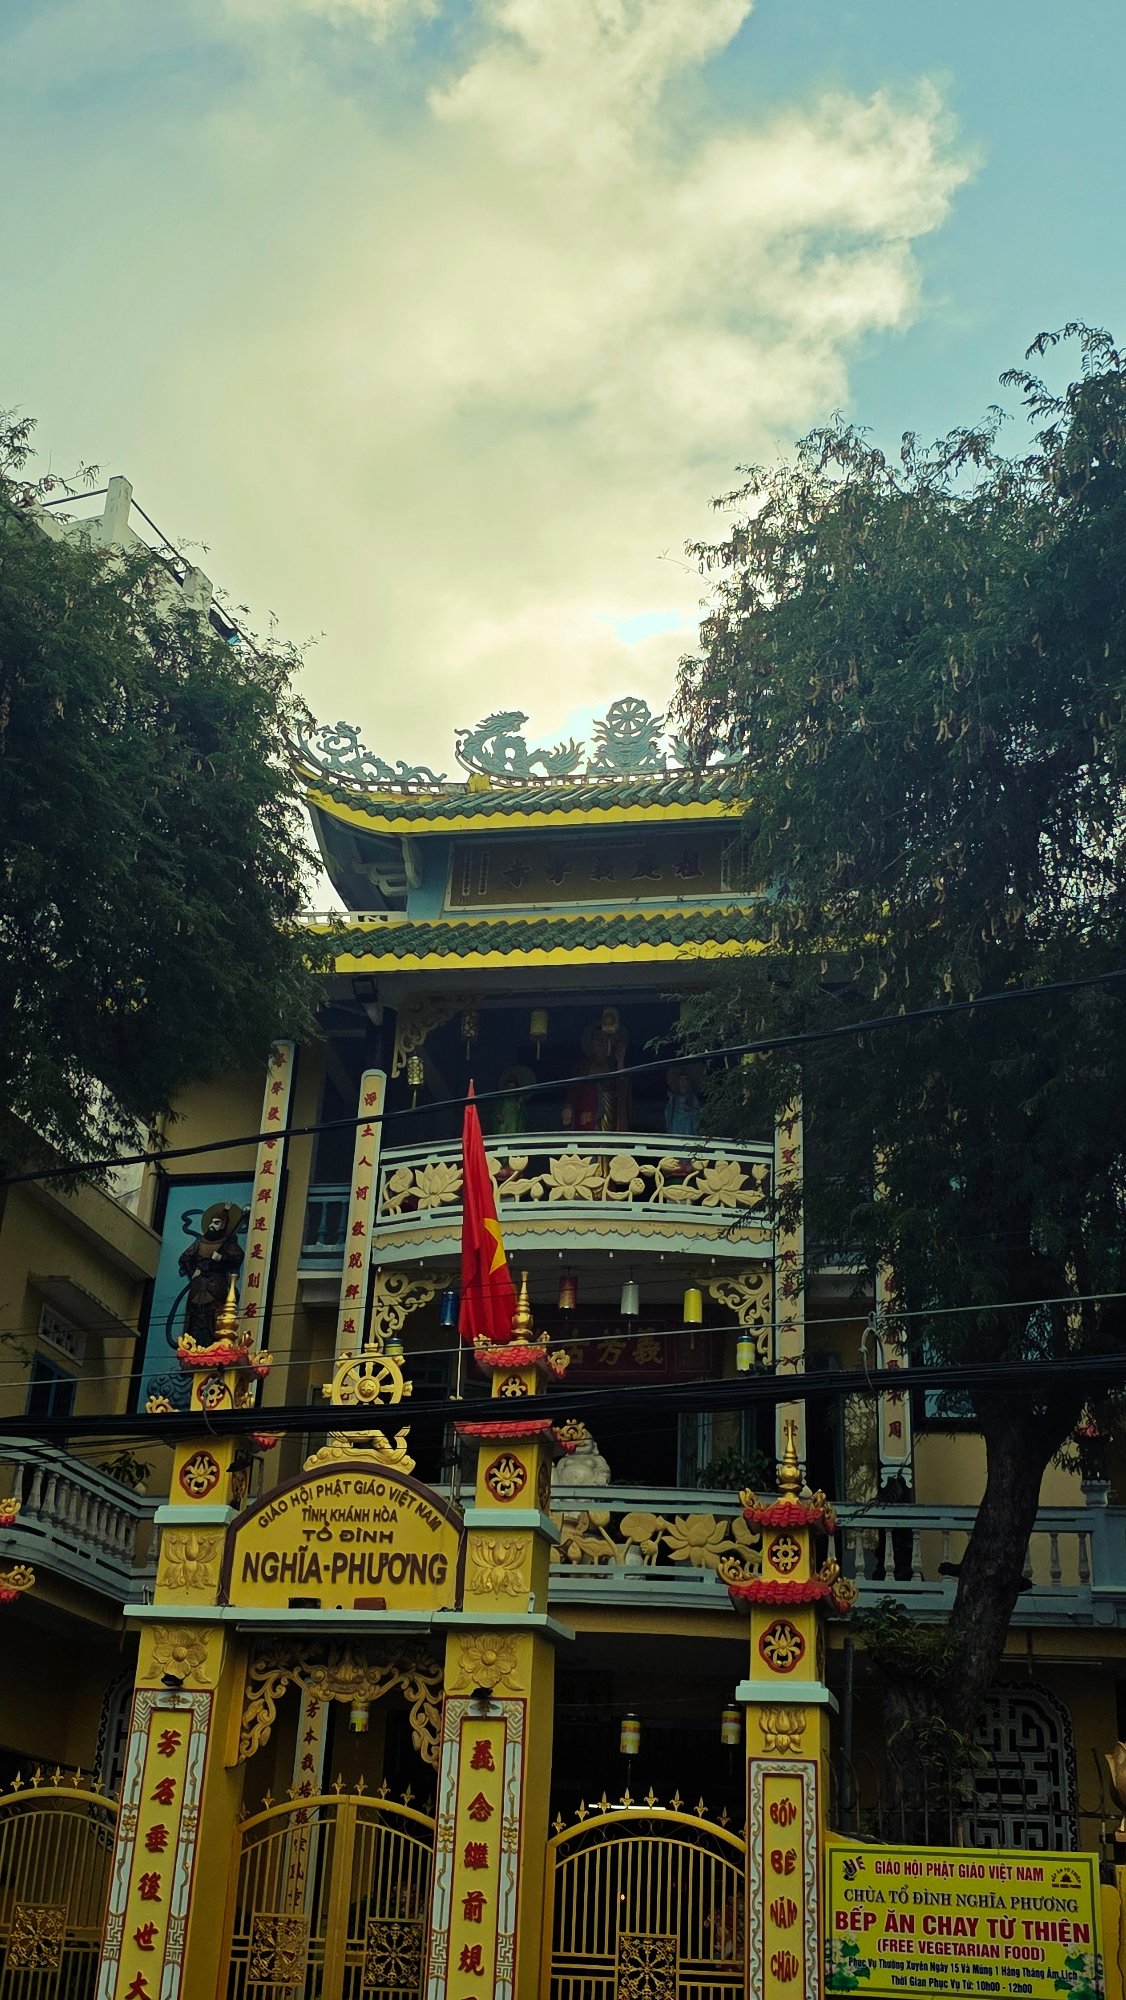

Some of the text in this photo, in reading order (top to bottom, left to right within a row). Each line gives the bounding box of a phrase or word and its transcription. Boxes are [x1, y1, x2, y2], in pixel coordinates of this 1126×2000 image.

[257, 1479, 444, 1532] GIÁO HỘI PHẬT GIÁO VIỆT NAM
[330, 1505, 370, 1522] KHÁNH
[373, 1505, 398, 1523] HÒA
[302, 1521, 394, 1544] TỔ ĐÌNH
[241, 1545, 448, 1585] NGHĨA-PHƯƠNG
[769, 1797, 797, 1827] BỐN
[457, 1739, 496, 2000] 義念繼前規
[874, 1860, 901, 1875] GIÁO
[904, 1861, 923, 1878] HỘI
[926, 1861, 955, 1881] PHẬT
[958, 1862, 986, 1879] GIÁO
[988, 1864, 1013, 1883] VIỆT
[1016, 1867, 1044, 1883] NAM
[769, 1896, 798, 1929] NĂM
[843, 1884, 1079, 1913] CHÙA TỔ ĐÌNH NGHĨA PHƯƠNG
[834, 1905, 1091, 1947] BẾP ĂN CHAY TỪ THIỆN
[877, 1938, 1046, 1962] (FREE VEGETARIAN FOOD)
[770, 1950, 800, 1983] CHÂU
[906, 1960, 928, 1972] Xuyên
[930, 1962, 948, 1973] Ngày
[951, 1963, 960, 1973] 15
[961, 1963, 971, 1974] Và
[1001, 1966, 1020, 1978] Hàng
[1022, 1967, 1045, 1979] Tháng
[1046, 1967, 1058, 1979] Âm
[909, 1976, 927, 1987] Gian
[928, 1977, 949, 1990] Phục
[950, 1978, 960, 1991] Vụ
[976, 1980, 1000, 1992] 10h00
[1008, 1983, 1033, 1994] 12h00
